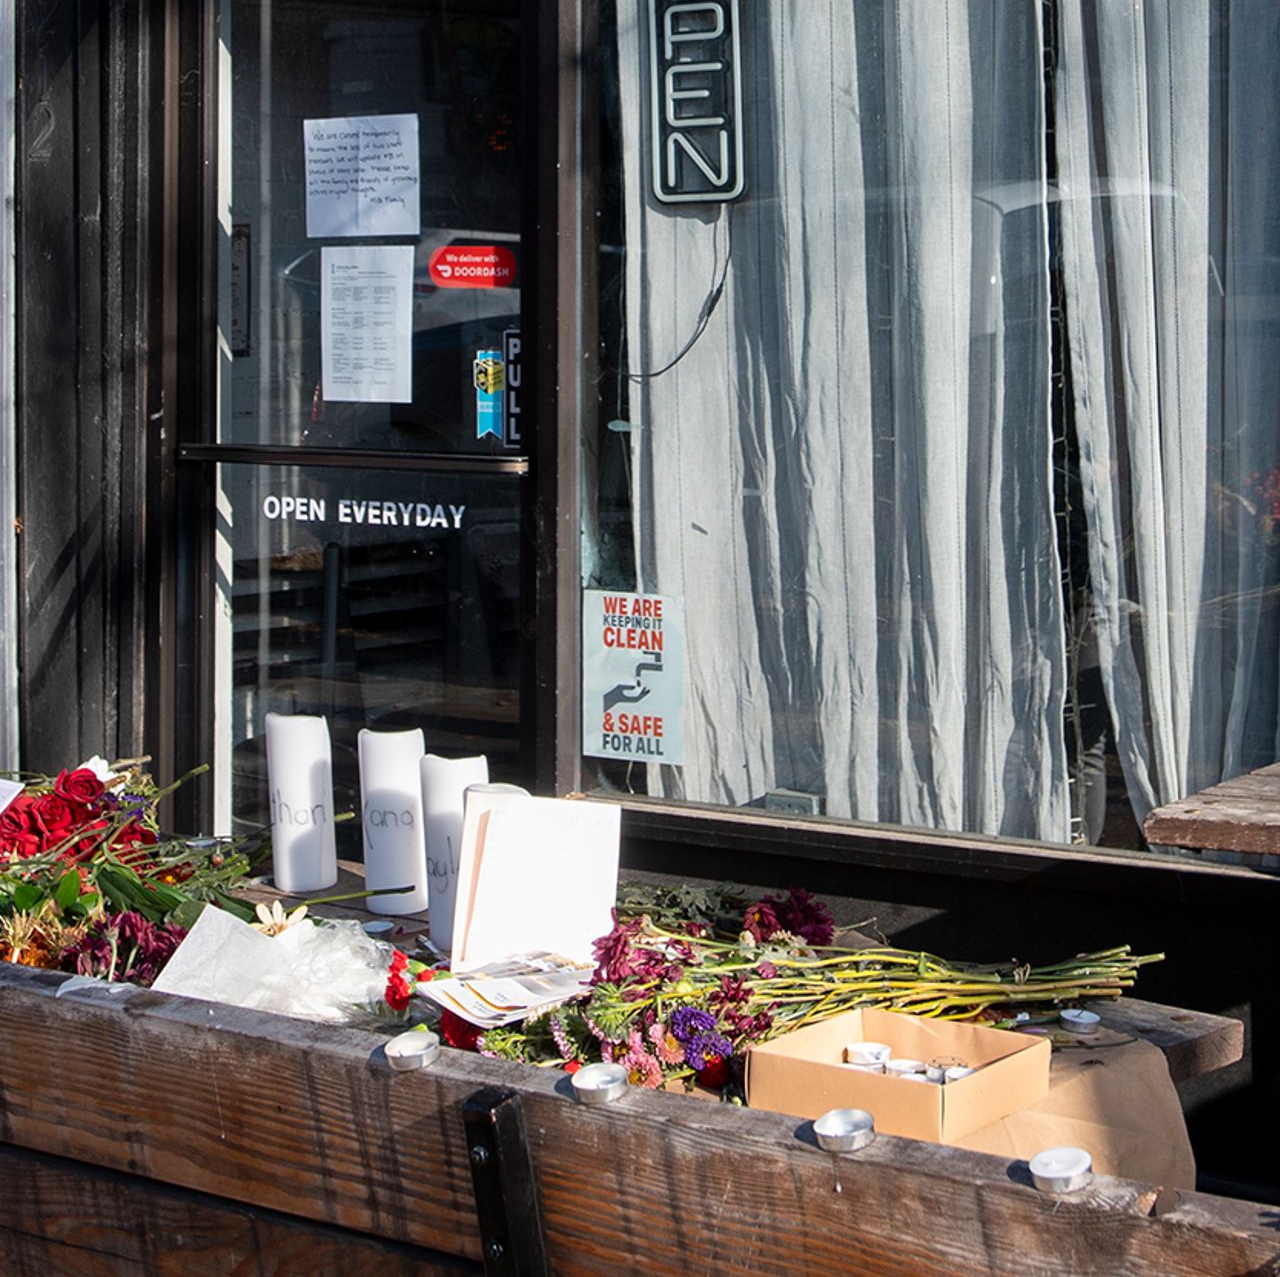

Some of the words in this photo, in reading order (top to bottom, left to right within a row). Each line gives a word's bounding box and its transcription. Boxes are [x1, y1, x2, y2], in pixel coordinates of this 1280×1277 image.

[458, 254, 483, 263] deliver
[454, 266, 510, 277] DOORDASH
[507, 337, 522, 441] PULL
[263, 496, 326, 523] OPEN
[338, 499, 466, 530] EVERYDAY
[603, 596, 628, 615] WE
[632, 598, 663, 617] ARE
[603, 614, 651, 629] KEEPING
[652, 618, 663, 630] IT
[603, 627, 663, 651] CLEAN
[603, 712, 615, 732] &
[618, 713, 664, 737] SAFE
[602, 733, 632, 753] FOR
[635, 737, 664, 756] ALL
